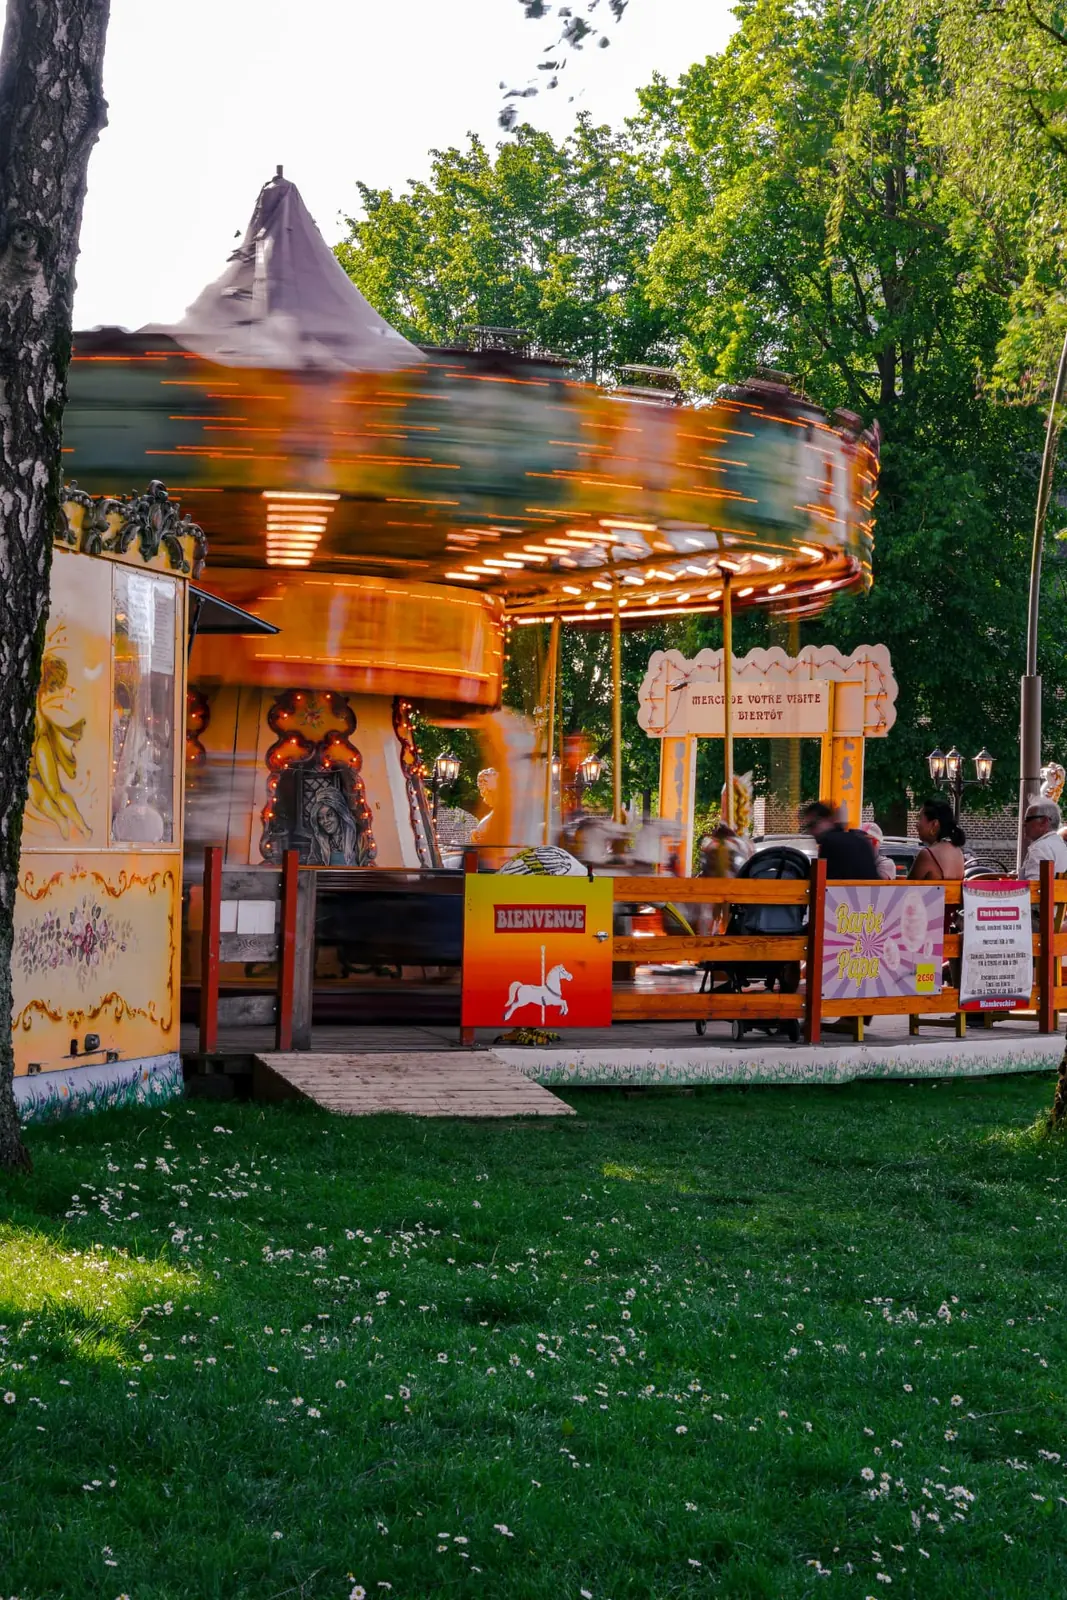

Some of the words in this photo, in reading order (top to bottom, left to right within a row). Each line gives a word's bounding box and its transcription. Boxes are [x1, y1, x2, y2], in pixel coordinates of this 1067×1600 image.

[692, 695, 725, 705] MERCI
[747, 694, 782, 704] VOTRE
[786, 693, 821, 704] VISITE
[496, 909, 585, 928] BIENVENUE
[835, 903, 884, 934] Barbe
[837, 949, 880, 989] Papa
